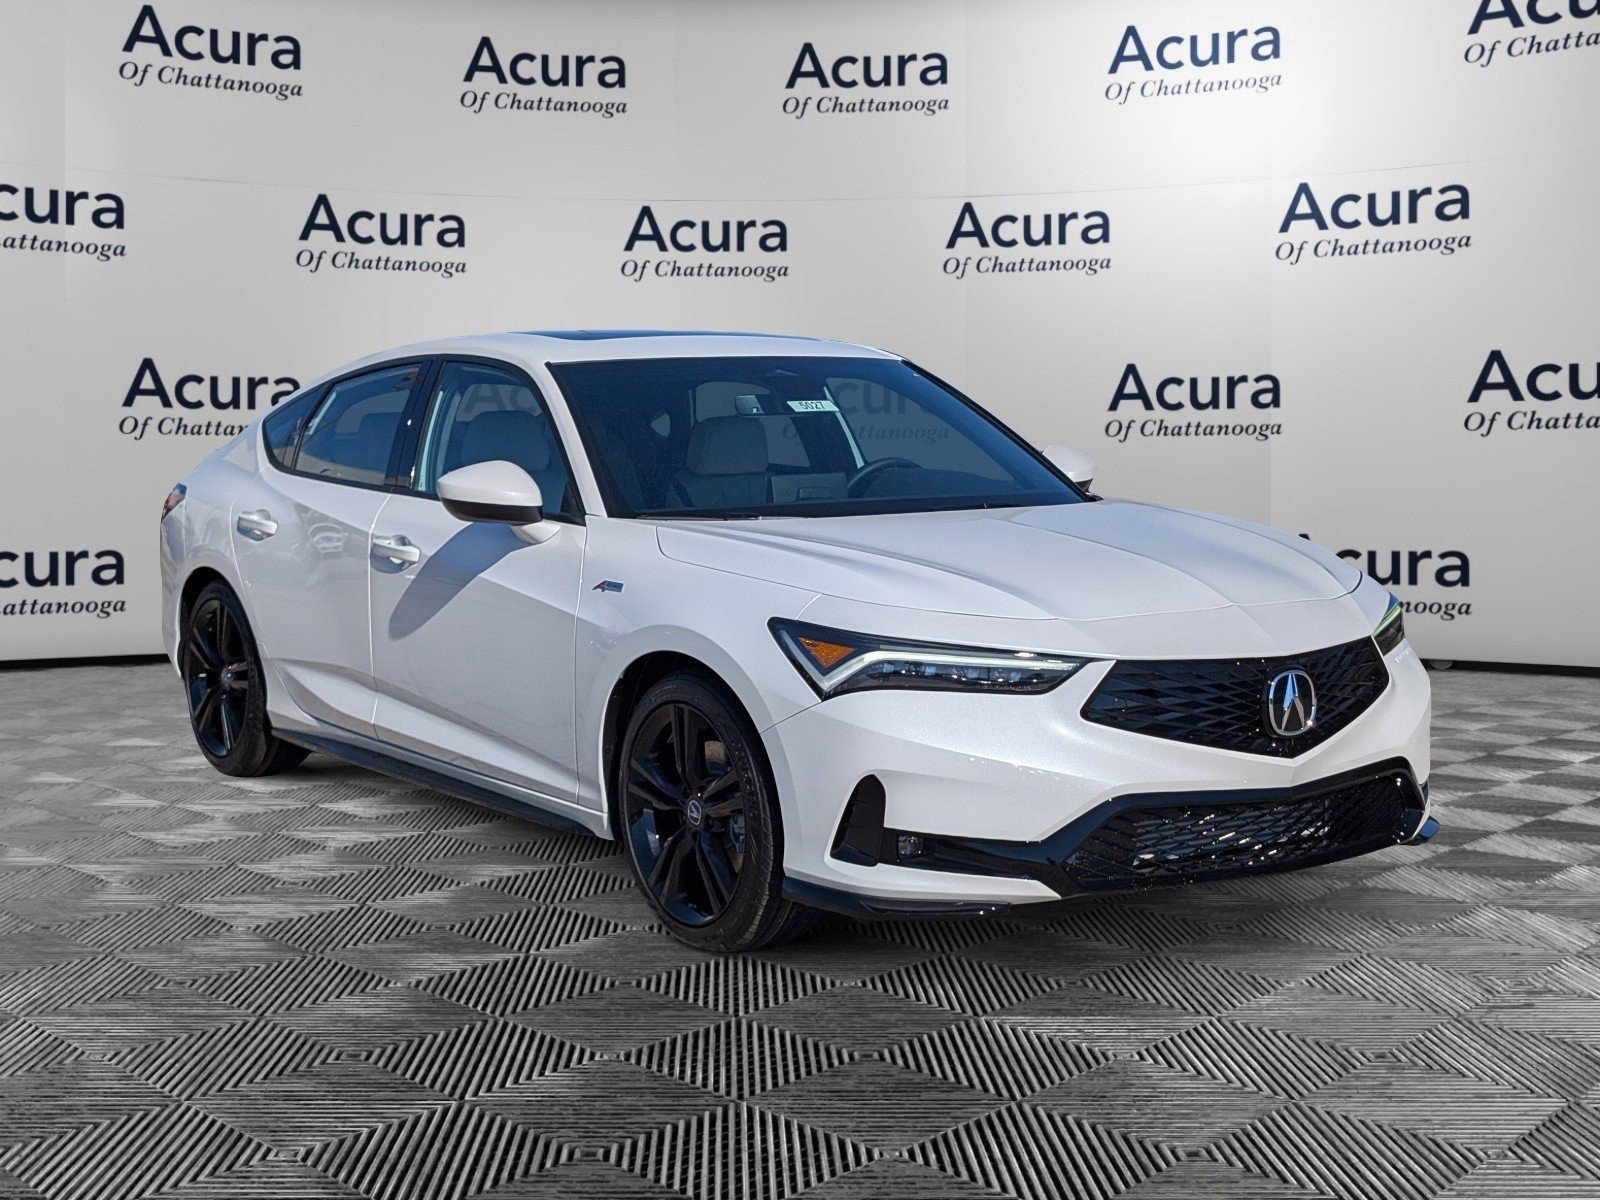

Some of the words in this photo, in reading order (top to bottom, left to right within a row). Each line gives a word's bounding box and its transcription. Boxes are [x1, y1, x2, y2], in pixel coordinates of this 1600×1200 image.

[121, 4, 301, 70] Acura
[1108, 25, 1281, 75] Acura
[1463, 40, 1501, 68] Of
[1507, 31, 1600, 57] Chatta
[119, 61, 154, 87] Of
[157, 66, 303, 101] Chattanooga
[463, 36, 626, 89] Acura
[785, 42, 948, 89] Acura
[460, 90, 491, 115] Of
[494, 92, 628, 119] Chattanooga
[782, 96, 813, 120] Of
[816, 96, 949, 117] Chattanooga
[1105, 81, 1137, 105] Of
[1140, 75, 1281, 97] Chattanooga
[0, 183, 125, 229] cura
[298, 193, 465, 248] Acura
[1278, 182, 1470, 233] Acura
[623, 205, 787, 253] Acura
[945, 202, 1110, 250] Acura
[0, 234, 127, 262] attanooga
[296, 249, 328, 275] Of
[331, 251, 467, 279] Chattanooga
[1275, 239, 1309, 265] Of
[1313, 236, 1472, 258] Chattanooga
[620, 259, 652, 283] Of
[655, 260, 789, 283] Chattanooga
[942, 256, 973, 280] Of
[976, 256, 1111, 275] Chattanooga
[1107, 363, 1281, 412] Acura
[1467, 349, 1600, 403] Acu
[798, 401, 826, 410] 5027
[1463, 411, 1502, 438] Of
[1507, 410, 1600, 431] Chatta
[119, 415, 152, 441] Of
[1104, 419, 1137, 443] Of
[1140, 419, 1282, 442] Chattanooga
[0, 549, 125, 589] cura
[0, 599, 127, 619] attanooga
